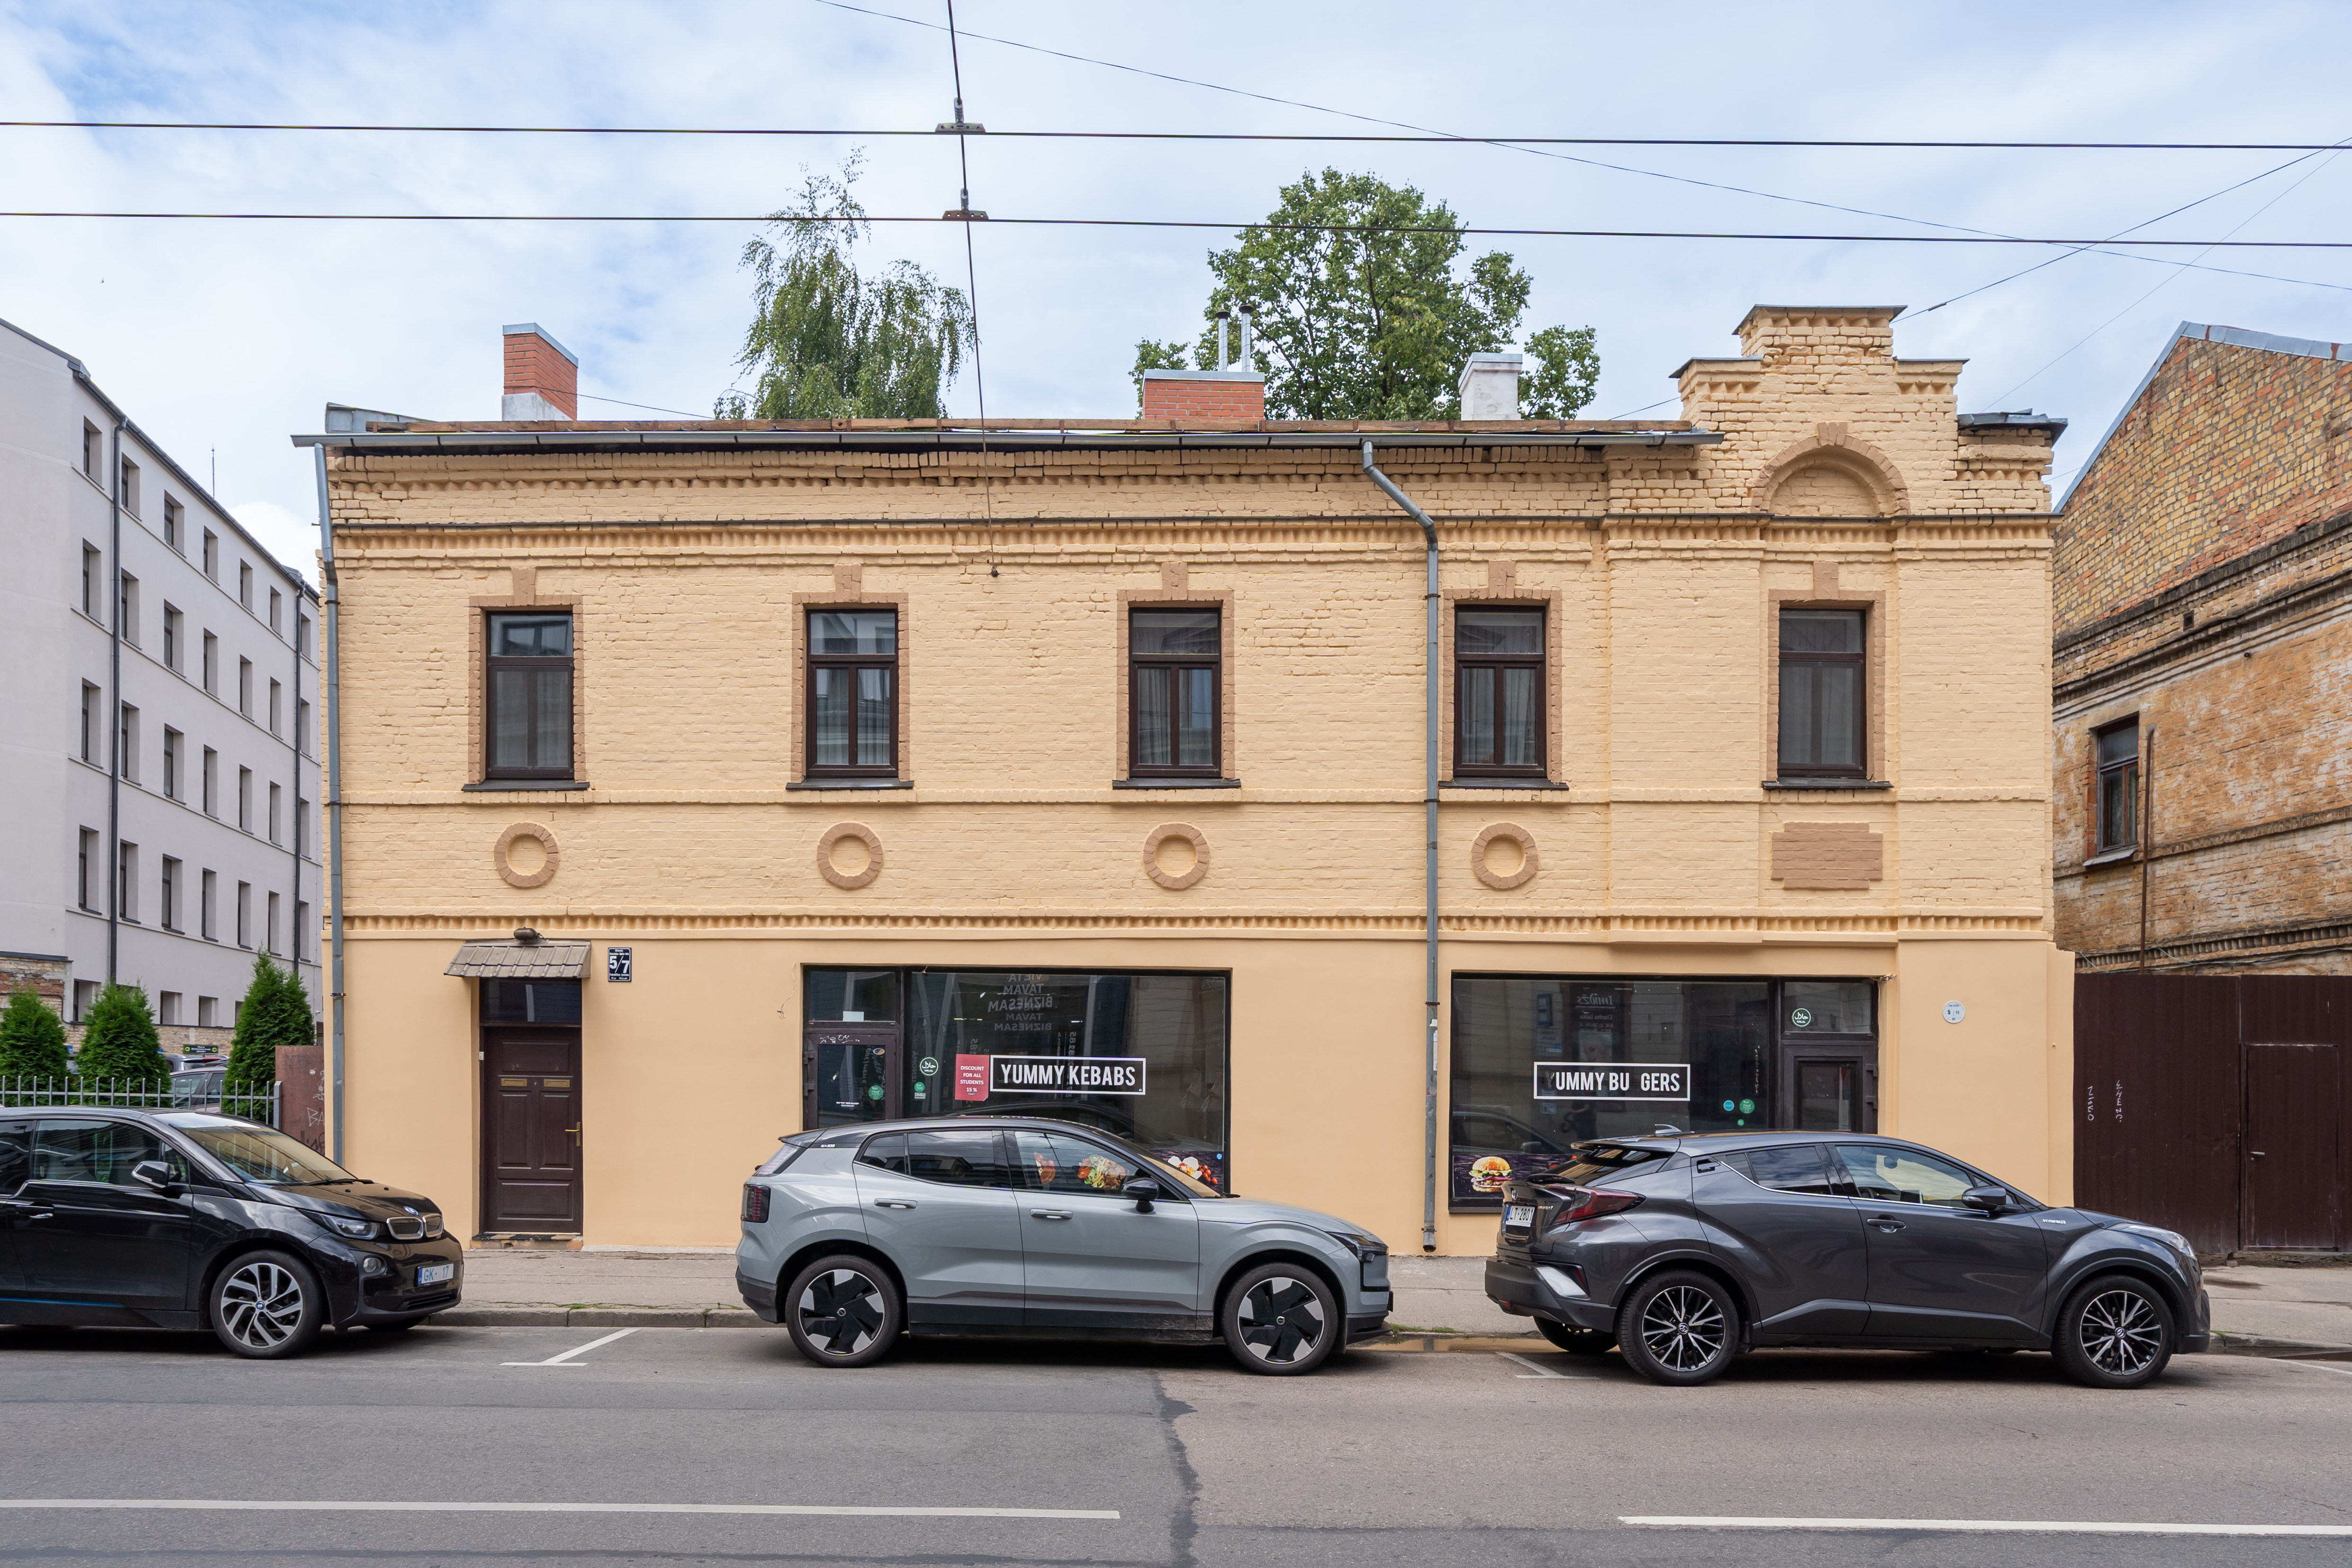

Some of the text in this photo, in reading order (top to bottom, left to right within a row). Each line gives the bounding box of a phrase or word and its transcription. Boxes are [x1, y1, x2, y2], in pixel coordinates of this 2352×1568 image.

[609, 955, 630, 973] 5/7
[1001, 1064, 1136, 1086] YUMMY KEBABS
[1546, 1072, 1605, 1091] UMMY
